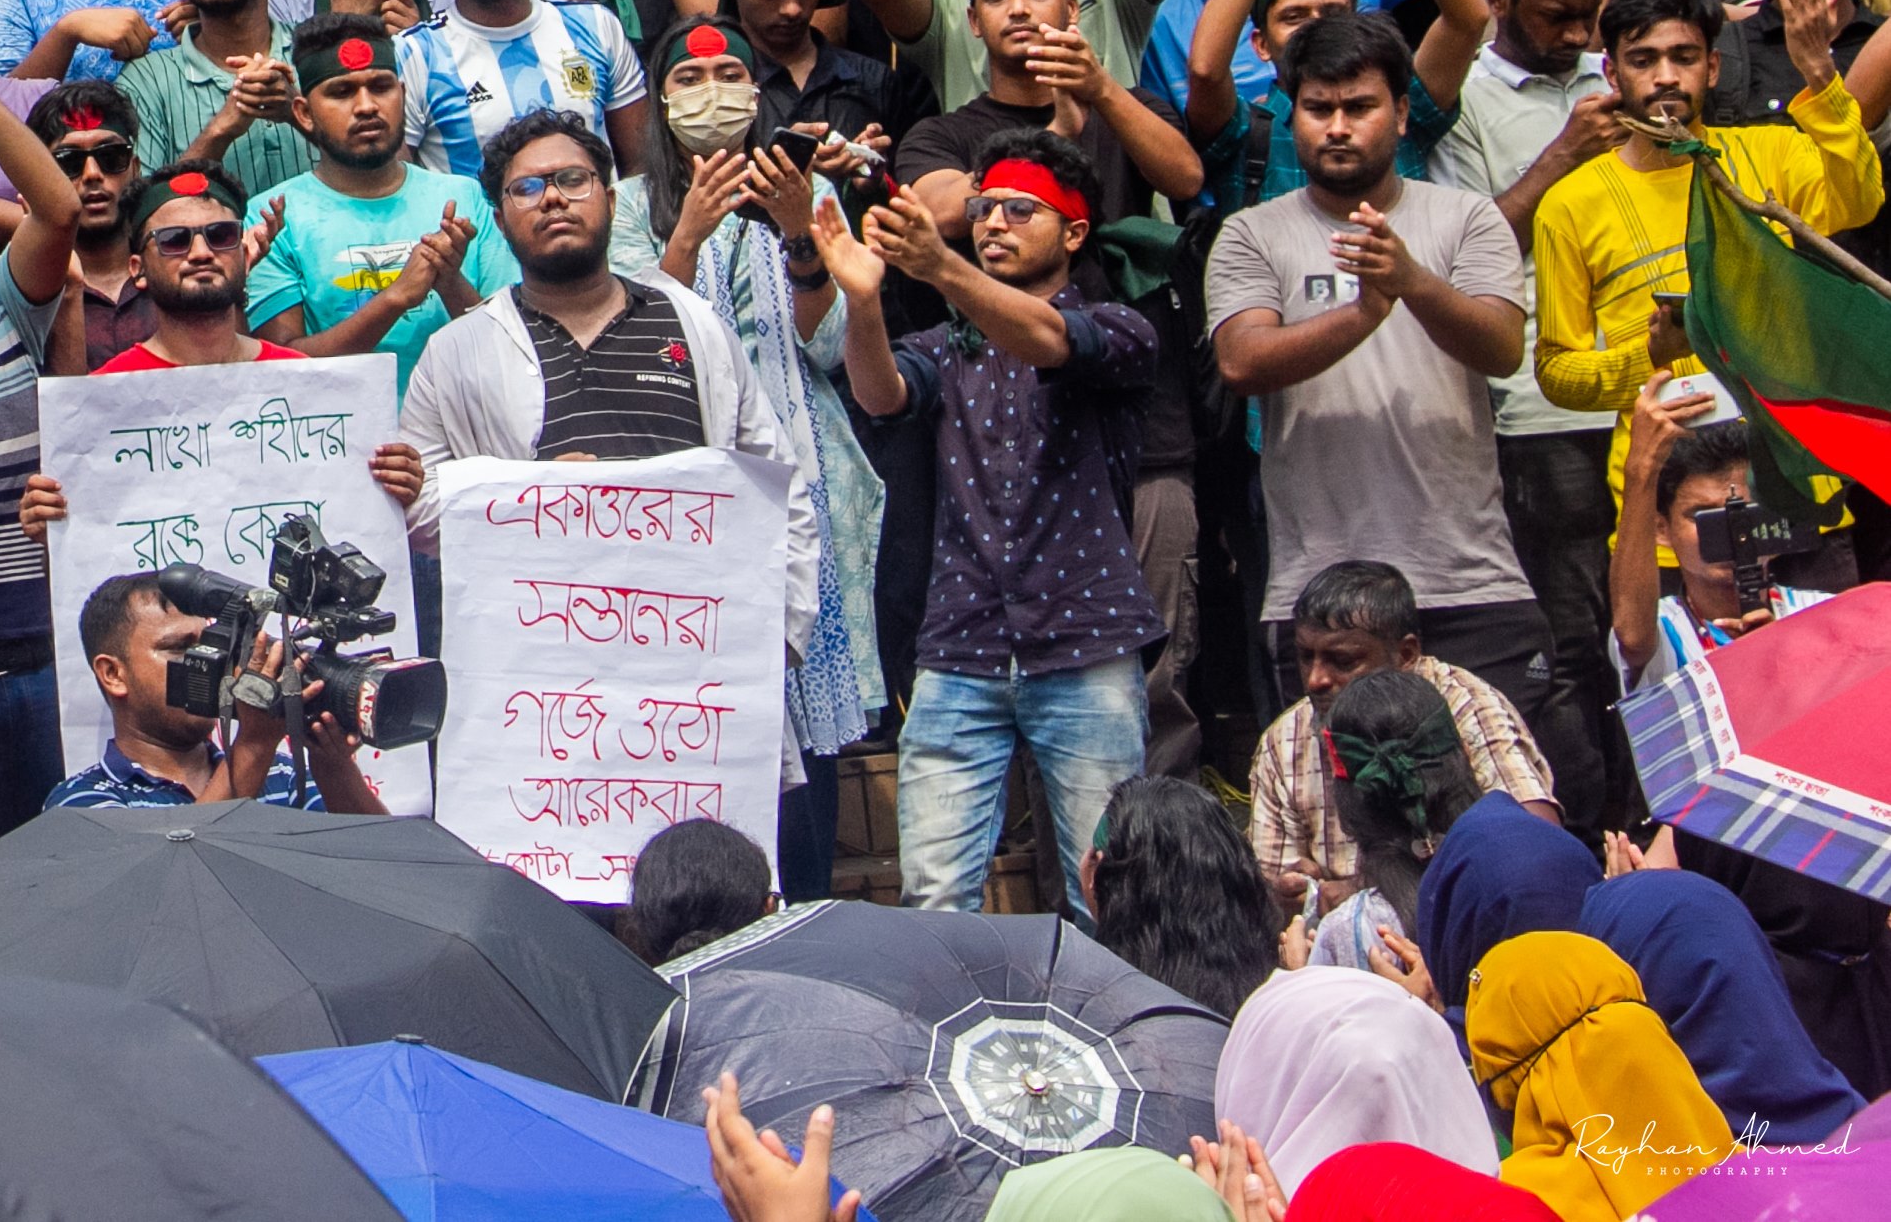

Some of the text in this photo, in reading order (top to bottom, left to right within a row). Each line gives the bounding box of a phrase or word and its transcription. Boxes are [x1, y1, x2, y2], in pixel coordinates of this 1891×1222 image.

[111, 397, 353, 472] লাখো শহীদের
[512, 579, 725, 654] সন্তানেরা
[504, 678, 607, 761] গর্জে
